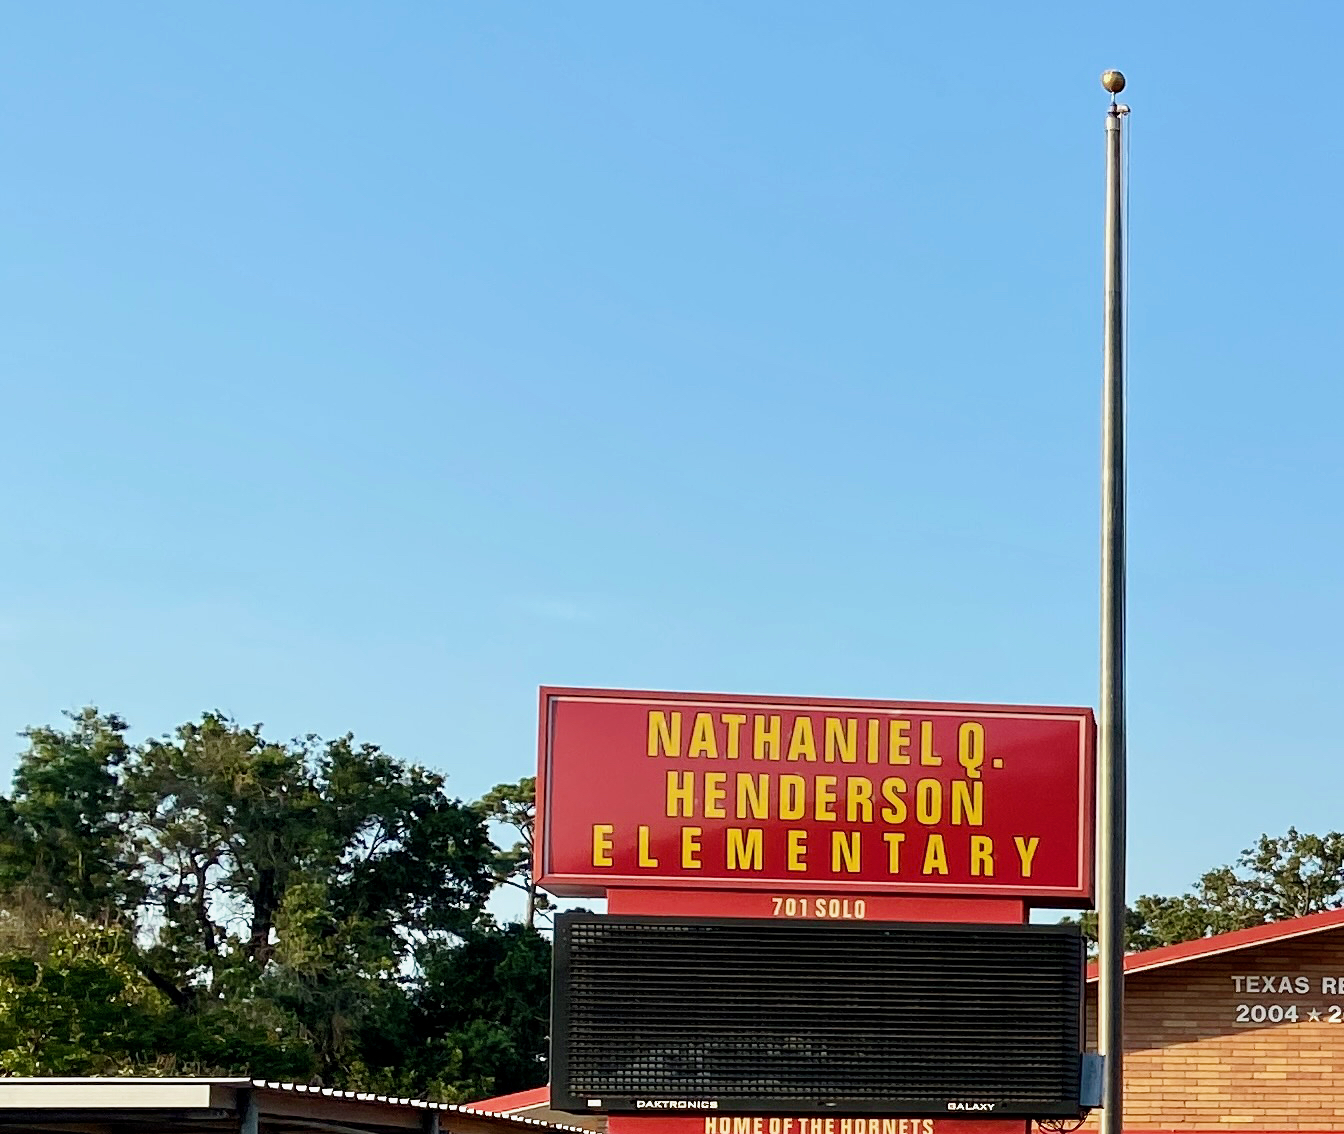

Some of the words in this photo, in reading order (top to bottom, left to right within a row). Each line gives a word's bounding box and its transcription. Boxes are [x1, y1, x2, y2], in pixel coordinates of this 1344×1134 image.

[647, 711, 942, 767] NATHANIEL
[957, 721, 1004, 778] Q.
[666, 770, 984, 826] HENDERSON
[592, 825, 1040, 877] ELEMENTARY
[772, 896, 808, 917] 701
[815, 898, 865, 919] SOLO
[1231, 975, 1310, 994] TEXAS
[1235, 1004, 1299, 1023] 2004
[636, 1100, 719, 1109] DAKTRONICS
[947, 1102, 995, 1111] GALAXY
